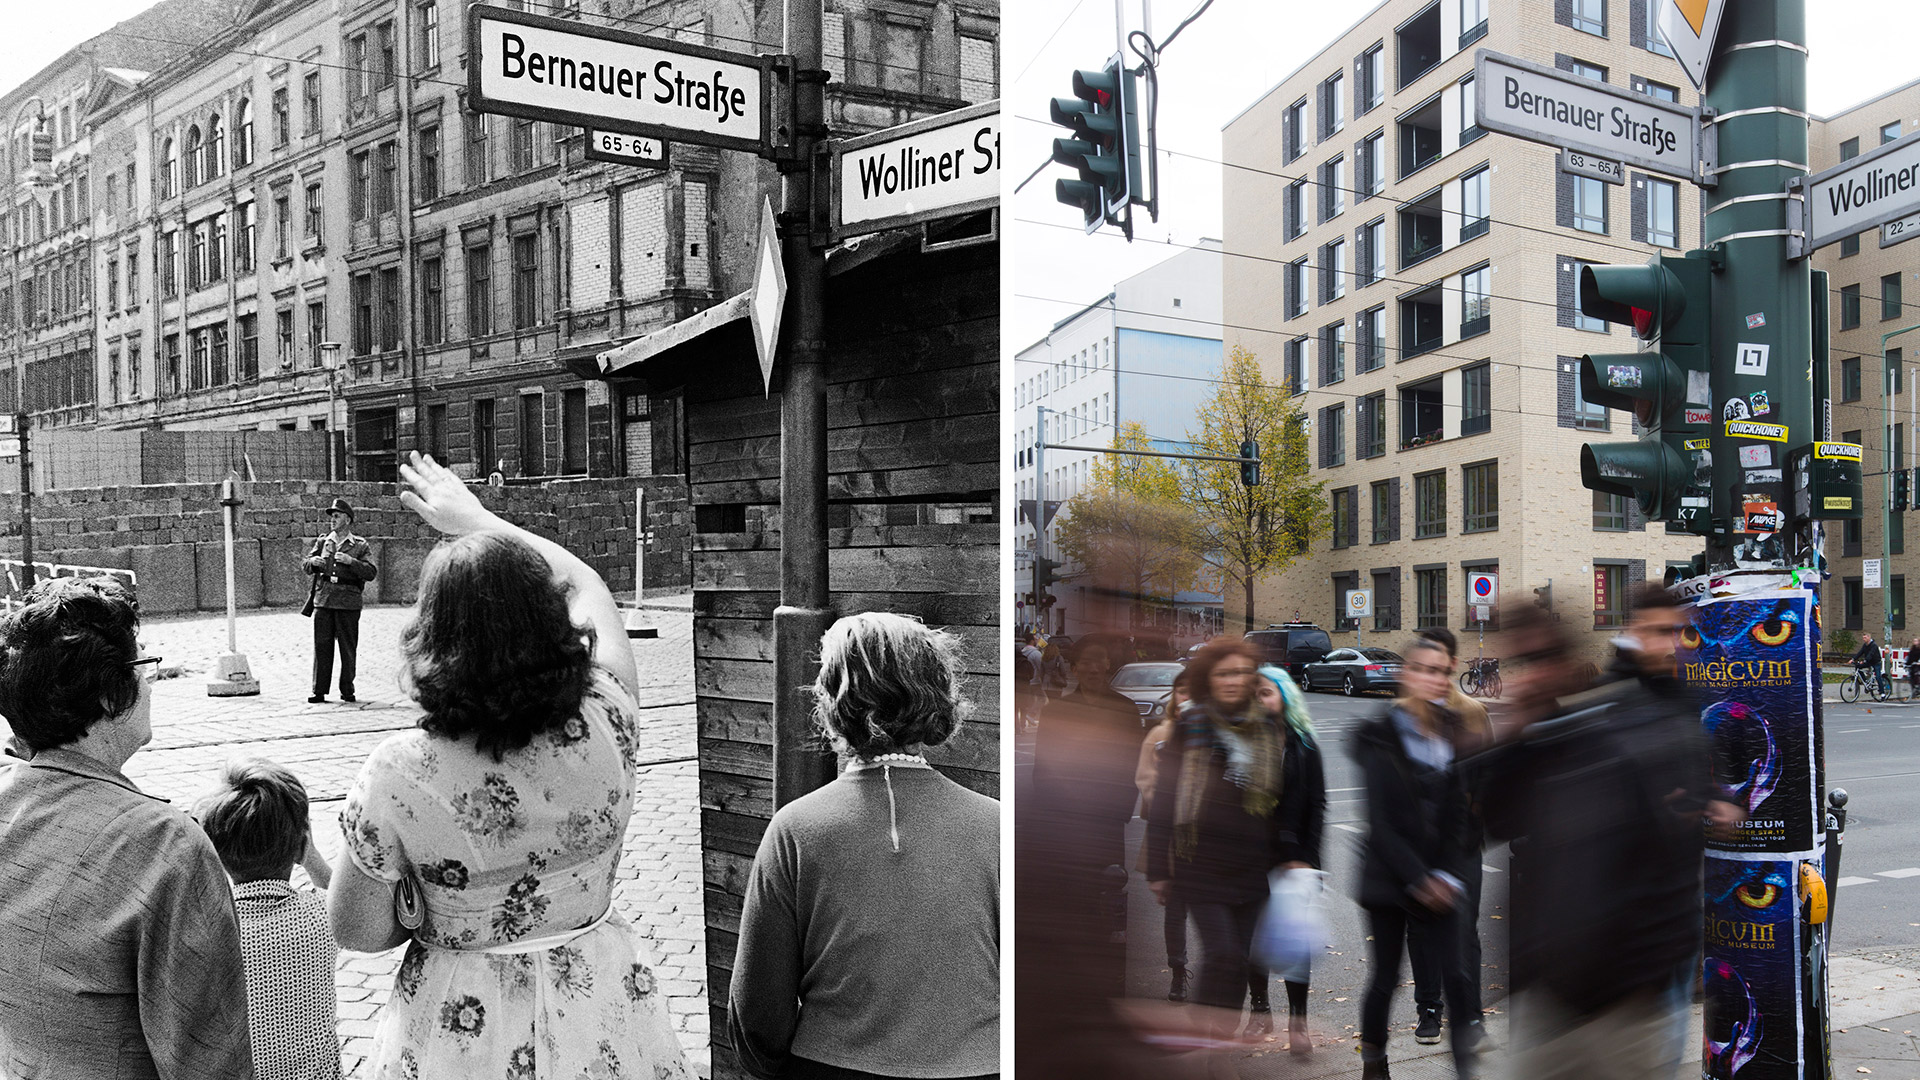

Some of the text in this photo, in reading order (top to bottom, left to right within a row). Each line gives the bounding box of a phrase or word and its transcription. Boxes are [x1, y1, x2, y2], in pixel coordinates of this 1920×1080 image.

[501, 32, 746, 123] Bernauer Straße
[1504, 76, 1676, 155] Bernauer Straße
[1570, 154, 1584, 168] 63
[858, 146, 964, 200] Wolliner
[1828, 162, 1920, 217] Wolliner
[1890, 221, 1904, 236] 22
[1729, 421, 1786, 438] QUICKHONEY
[1354, 596, 1364, 605] 30
[1742, 679, 1792, 687] MUSEUM
[1727, 941, 1775, 950] MUSEUM
